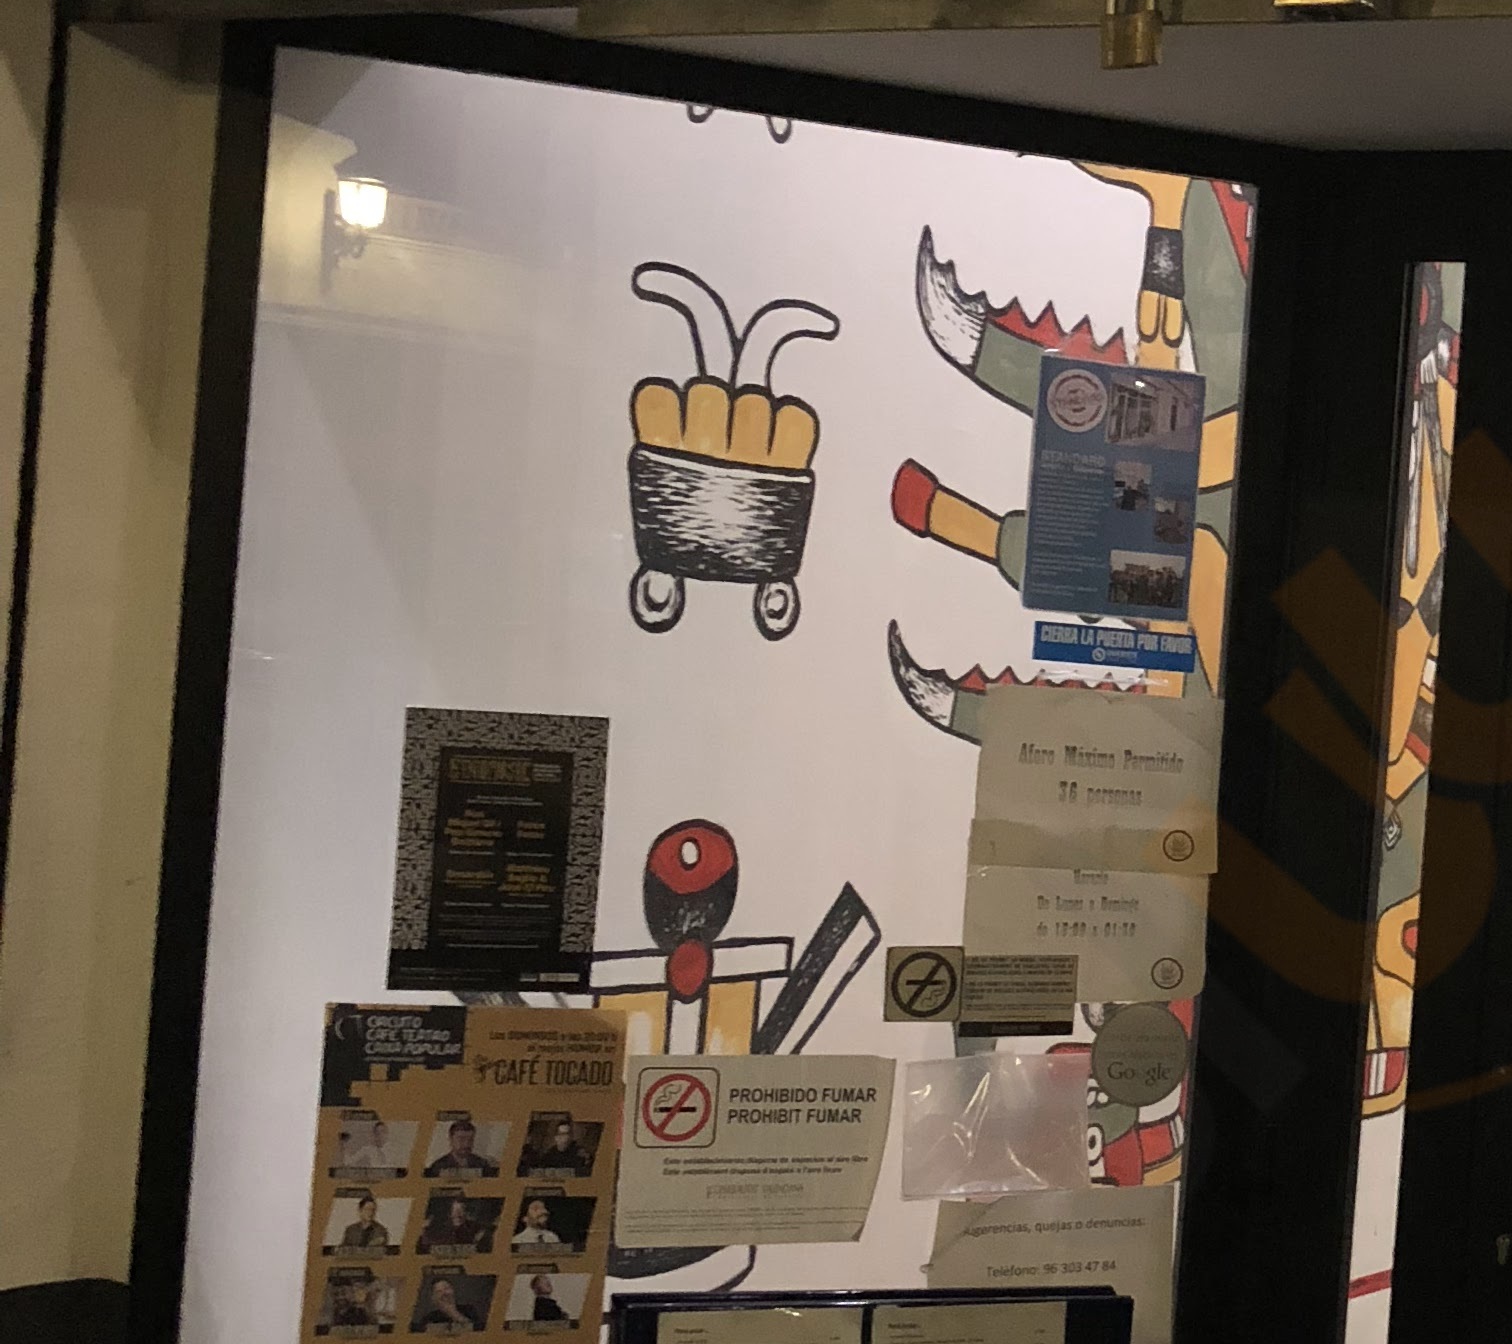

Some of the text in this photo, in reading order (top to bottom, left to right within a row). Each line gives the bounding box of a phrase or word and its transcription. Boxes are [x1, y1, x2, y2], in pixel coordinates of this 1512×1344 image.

[1040, 624, 1193, 655] CIERRA LA PUERTA POR FAVOR
[1018, 742, 1185, 774] Aforo Máximo Permitido
[1086, 786, 1143, 807] personas
[495, 1054, 614, 1086] CAFÉ TOCADO
[1107, 1061, 1171, 1087] Gogle
[729, 1087, 878, 1103] PROHIBIDO FUMAR
[727, 1108, 862, 1125] PROHIBIT FUMAR
[1035, 1220, 1073, 1233] quejas
[1075, 1221, 1083, 1230] o
